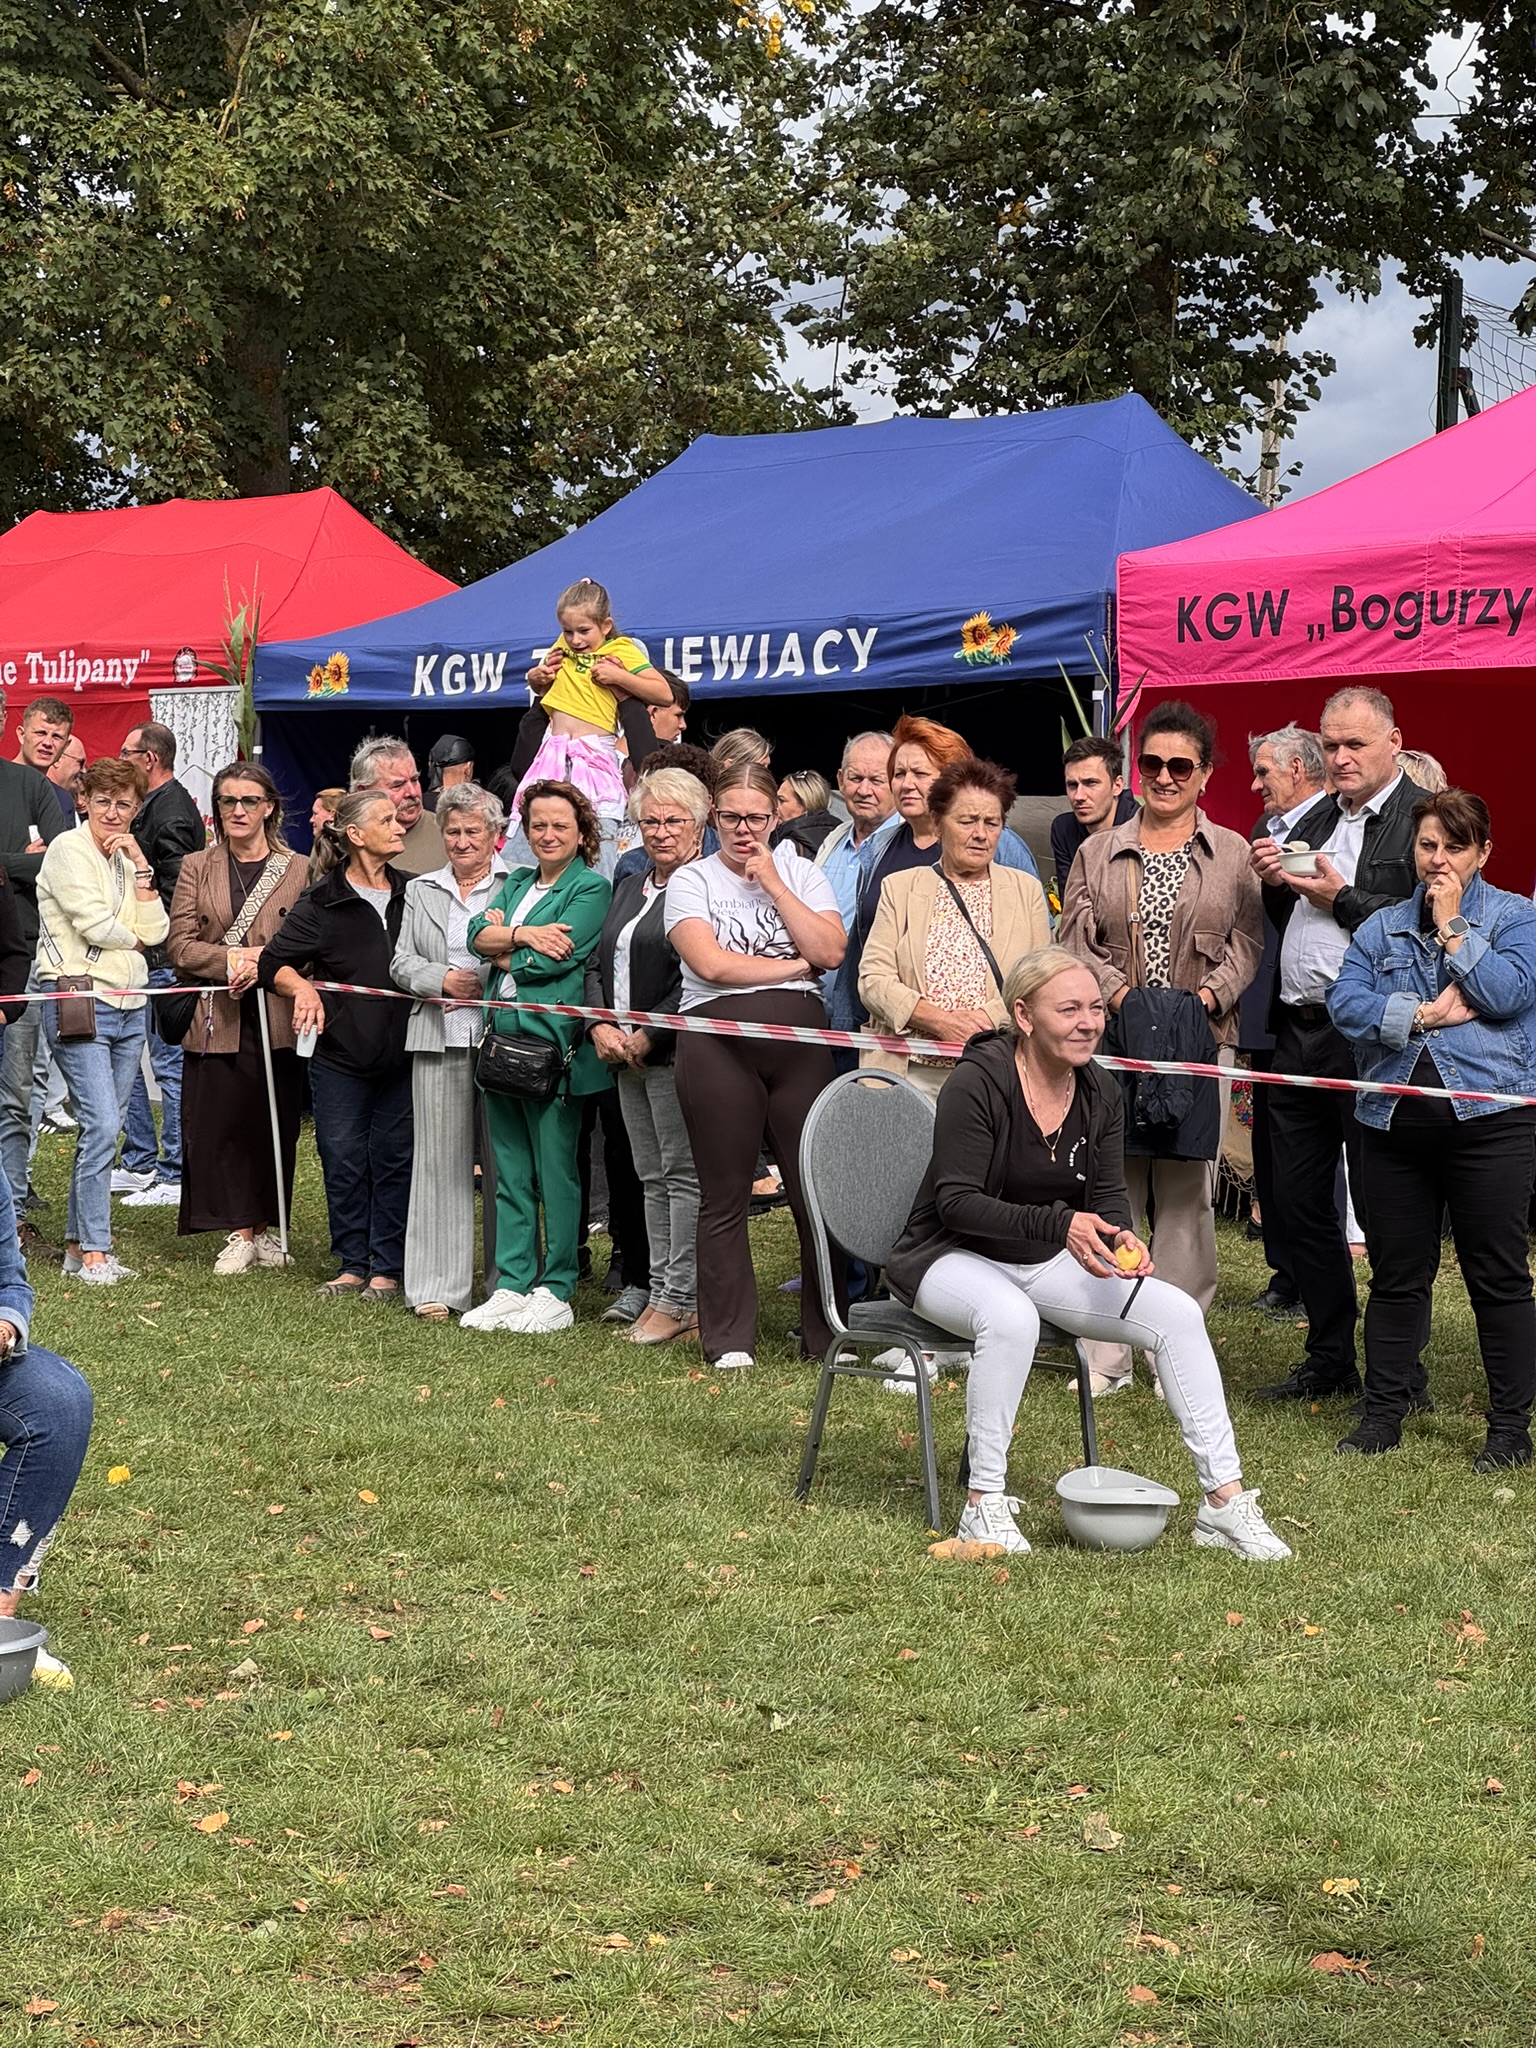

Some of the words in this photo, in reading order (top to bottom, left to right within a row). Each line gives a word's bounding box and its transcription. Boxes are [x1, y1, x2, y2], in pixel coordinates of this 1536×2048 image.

[1178, 589, 1290, 643] KGW
[1306, 585, 1536, 642] „Bogurzy
[25, 649, 150, 692] Tulipany"
[411, 652, 508, 697] KGW
